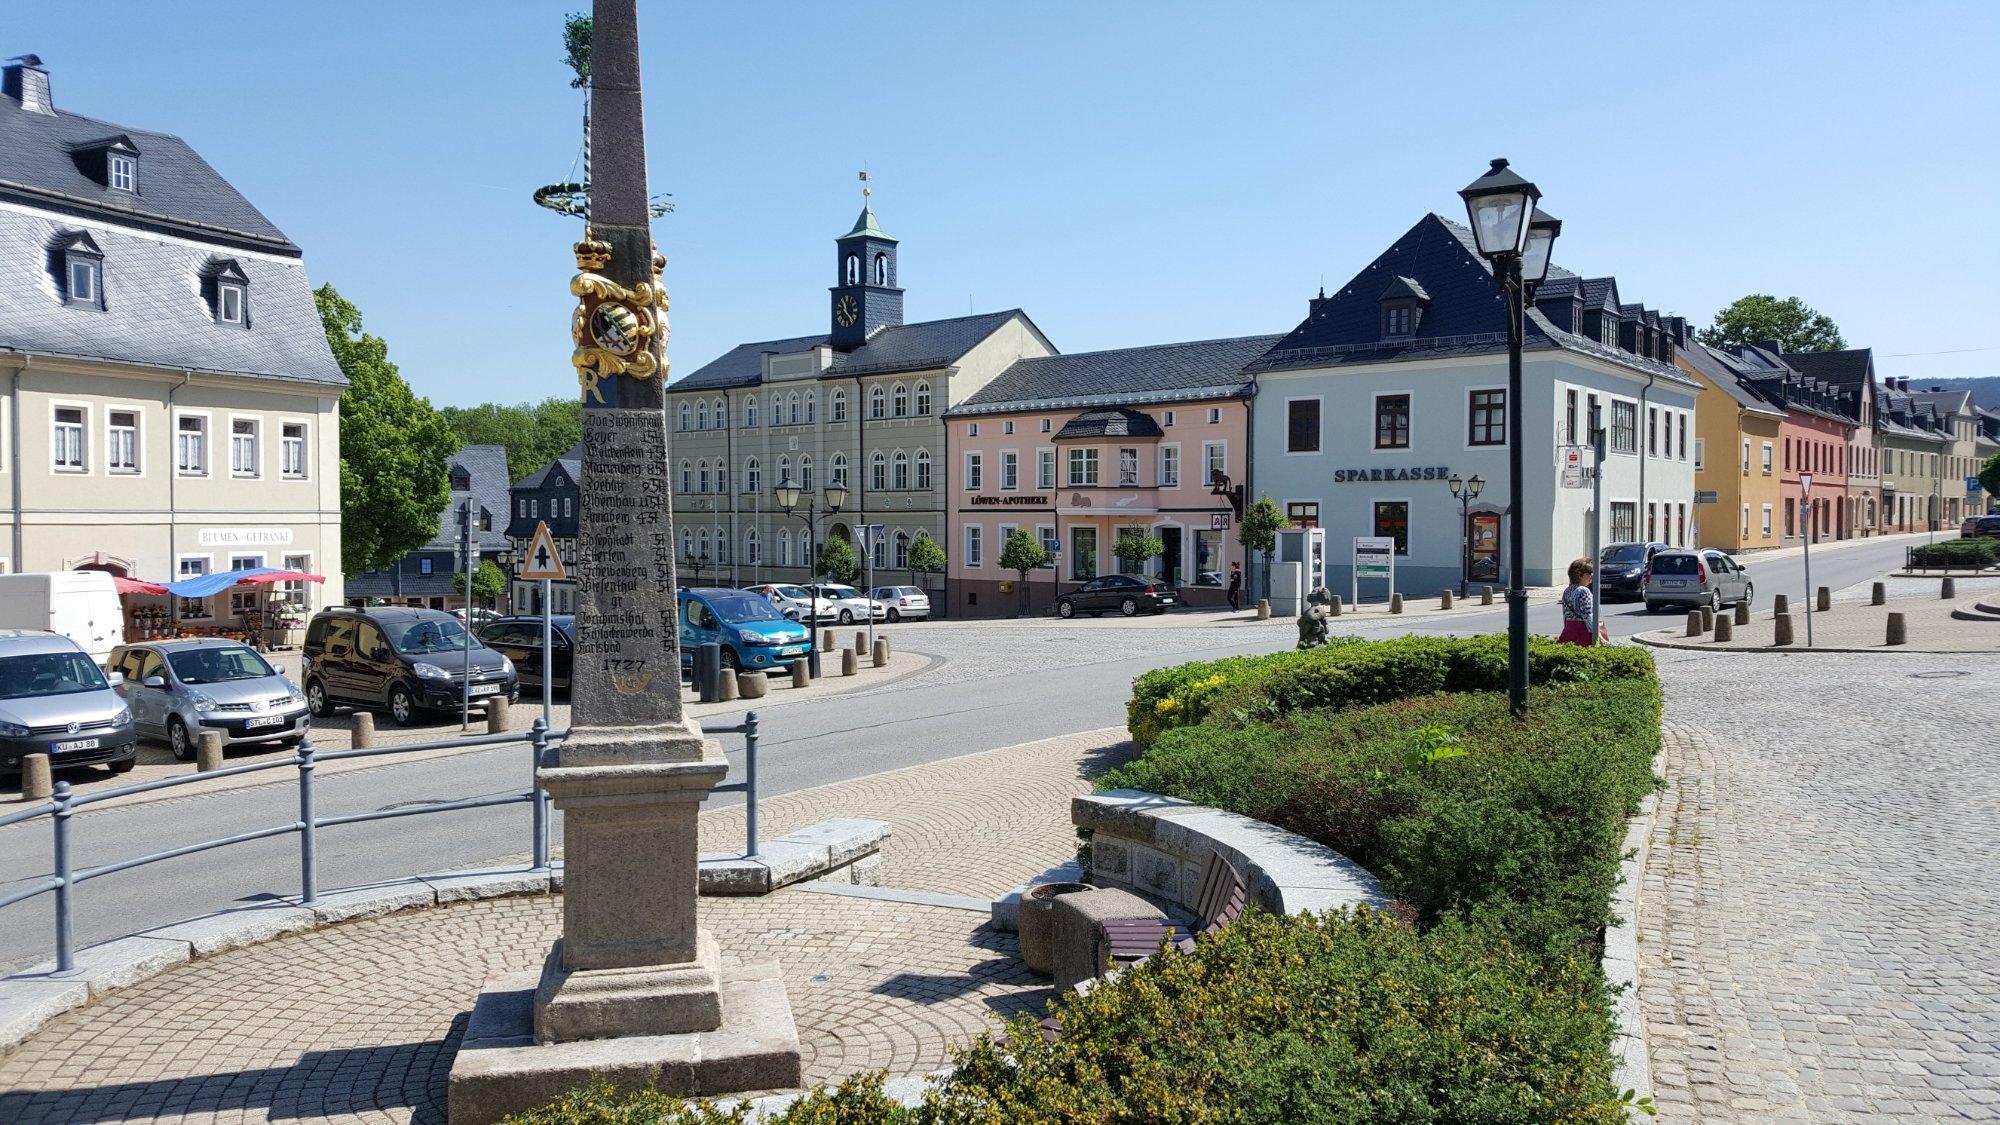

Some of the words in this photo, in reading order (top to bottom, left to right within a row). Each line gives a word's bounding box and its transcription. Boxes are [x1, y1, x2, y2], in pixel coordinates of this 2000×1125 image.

[584, 428, 617, 445] Geyer
[585, 460, 641, 478] Marienberg
[1334, 467, 1449, 483] SPARKASSE
[971, 495, 1048, 505] LÖWEN-APOTHEKE
[583, 508, 630, 525] Annaberg
[202, 532, 239, 542] BLUMEN
[577, 640, 621, 654] Karlsbad
[601, 659, 645, 672] 1727
[57, 743, 67, 751] KU
